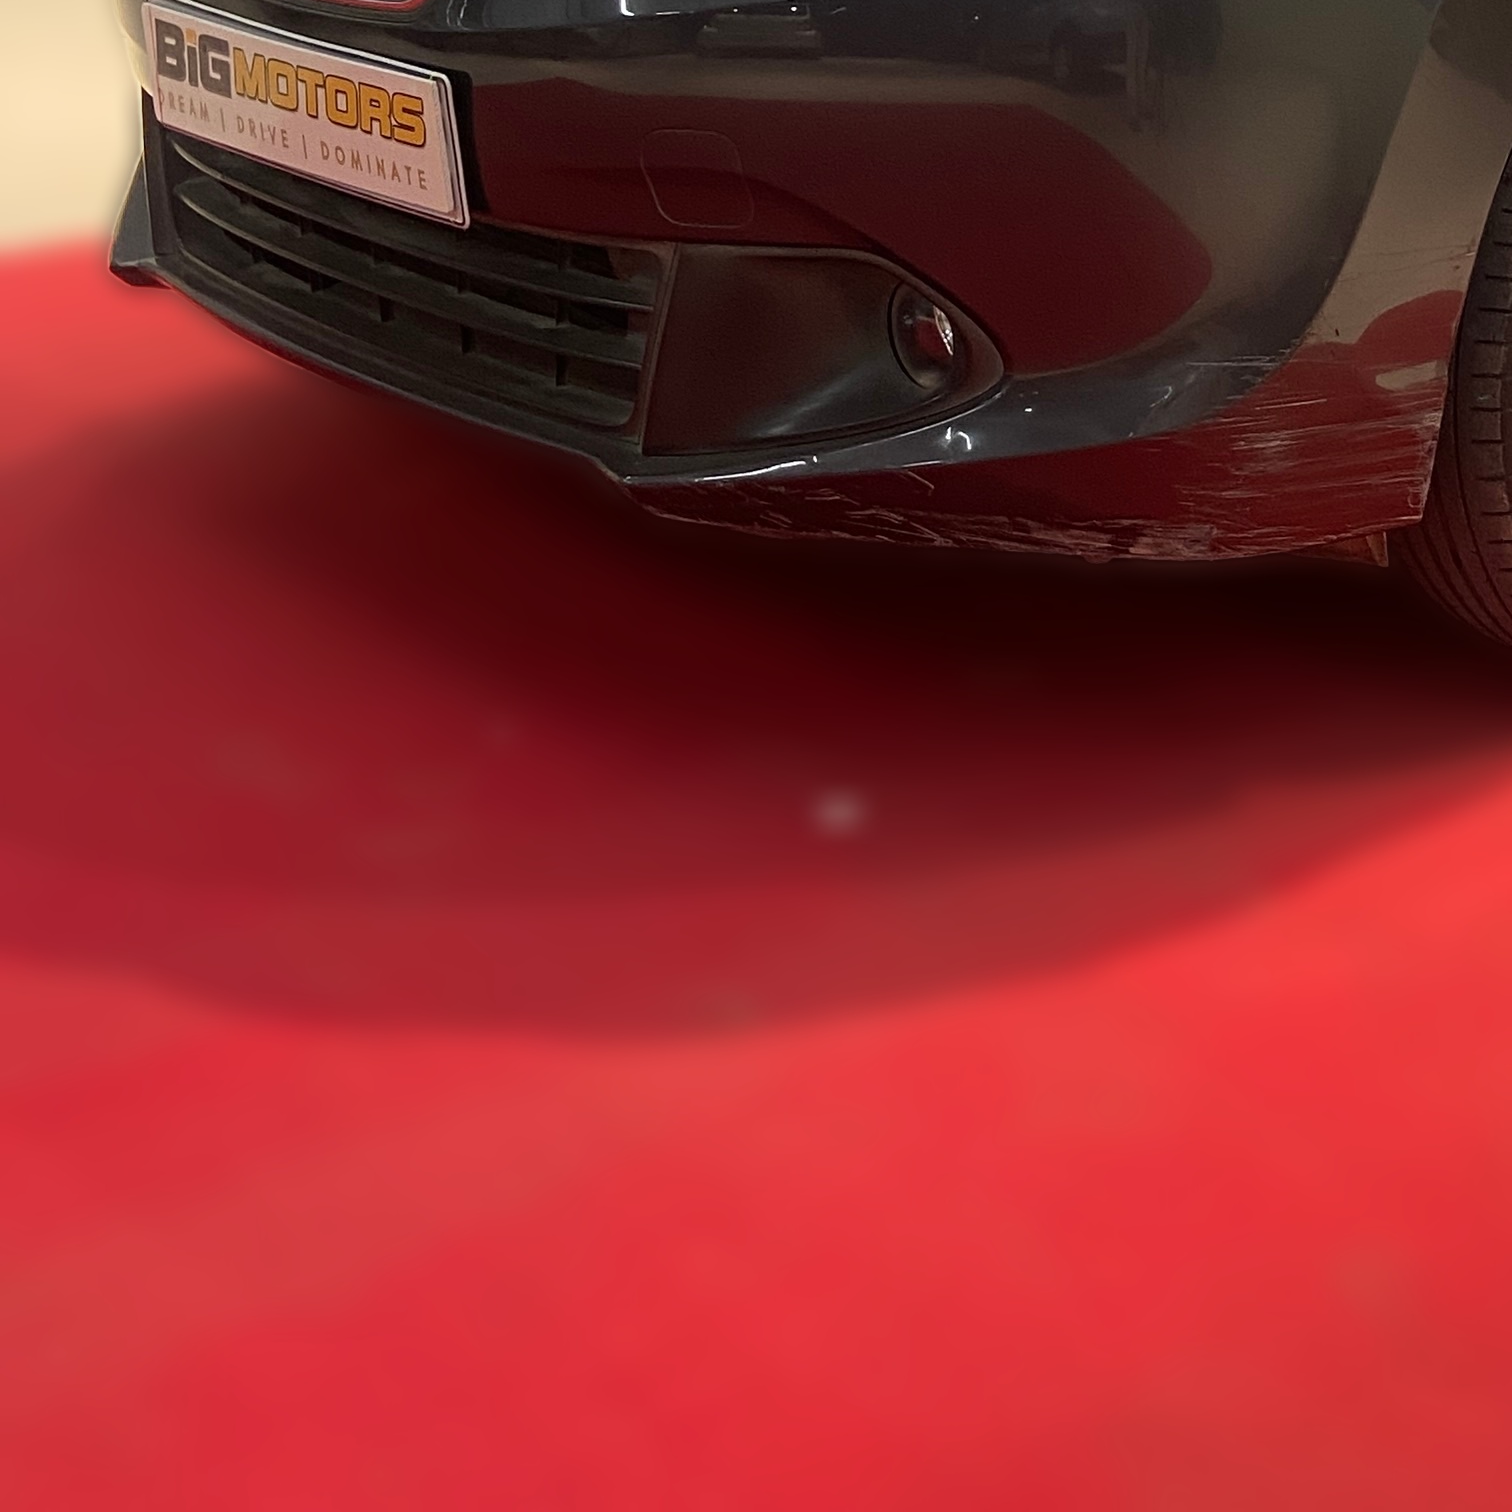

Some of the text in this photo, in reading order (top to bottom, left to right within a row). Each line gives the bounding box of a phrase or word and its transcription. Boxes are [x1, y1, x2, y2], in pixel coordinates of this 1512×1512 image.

[232, 46, 426, 147] MOTORS
[236, 115, 290, 150] DRIVE
[320, 141, 429, 191] DOMINATE
